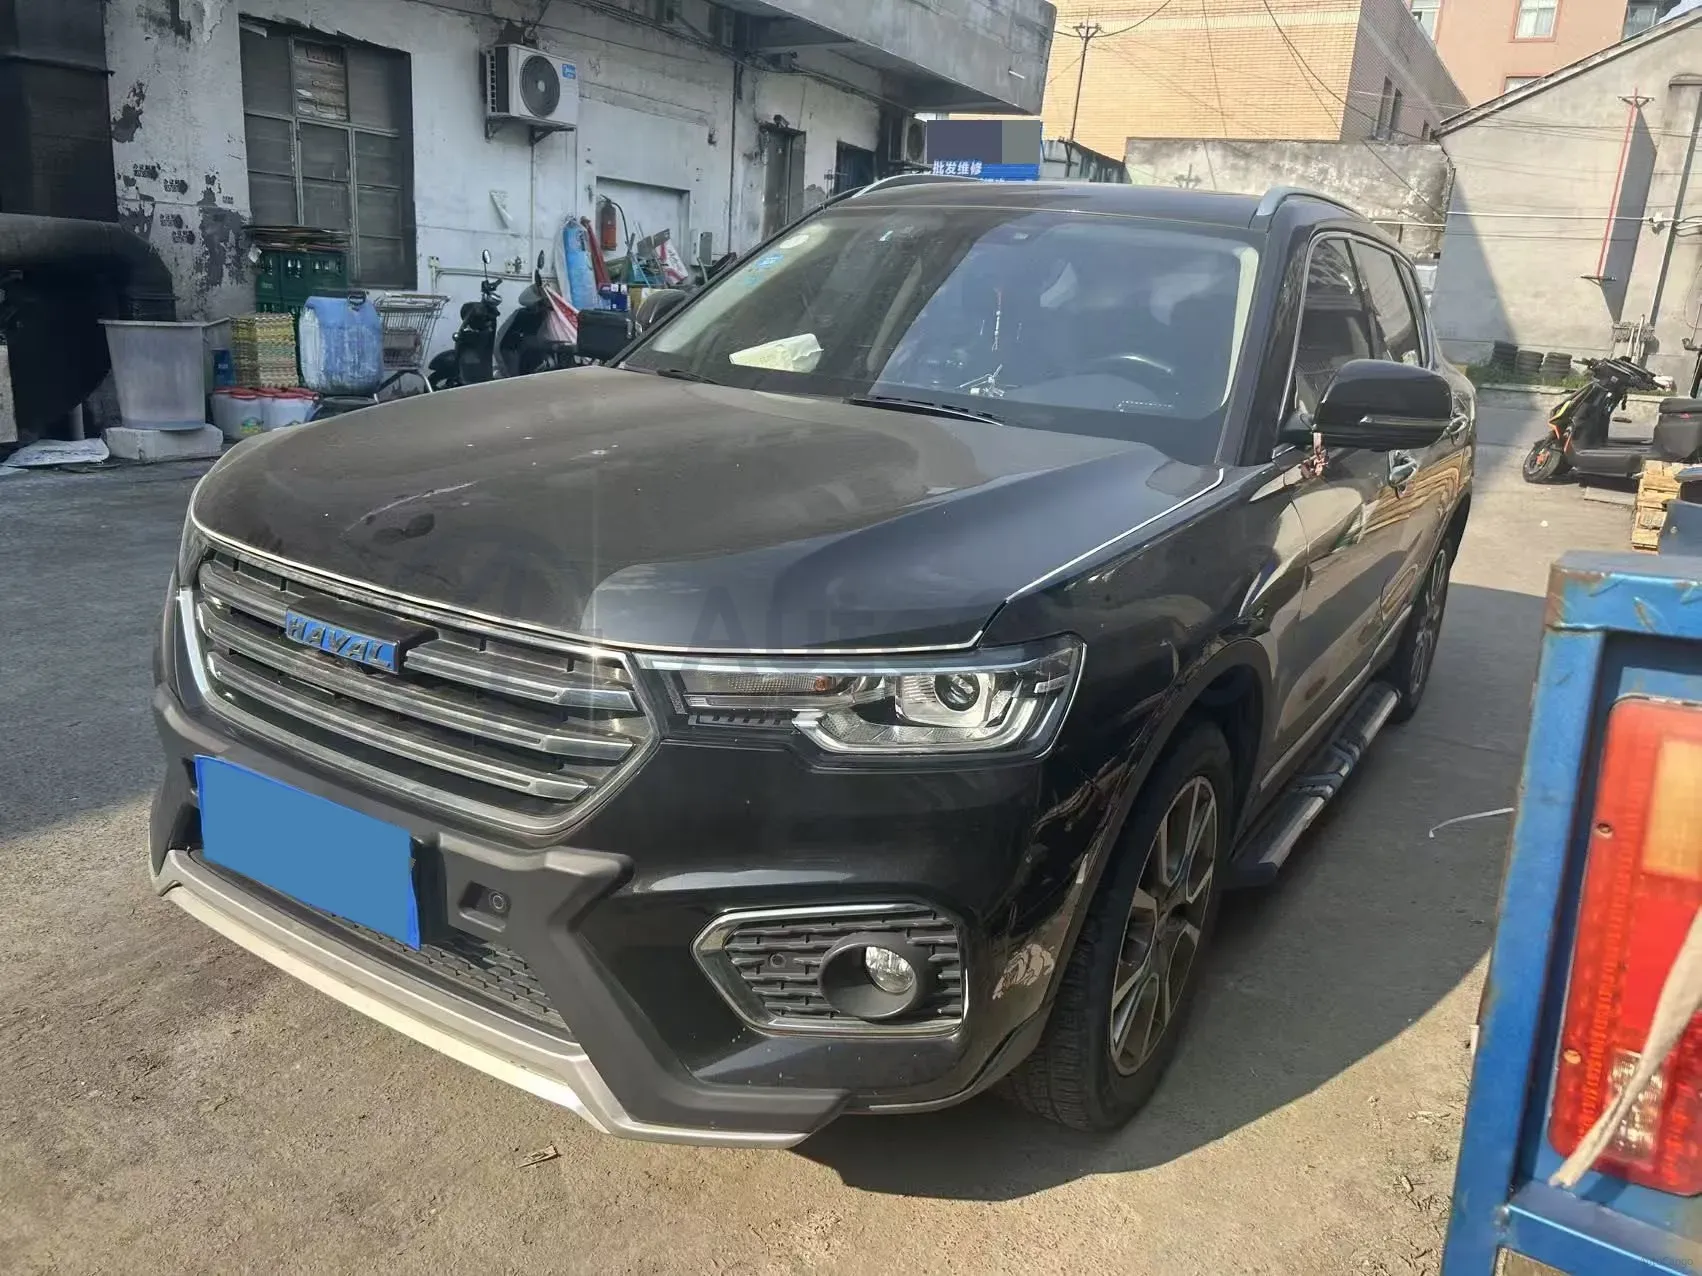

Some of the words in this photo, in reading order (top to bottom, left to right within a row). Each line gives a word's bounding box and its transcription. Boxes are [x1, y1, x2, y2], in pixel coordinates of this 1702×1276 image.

[933, 160, 982, 175] 批发维修
[288, 616, 392, 667] HAVAL
